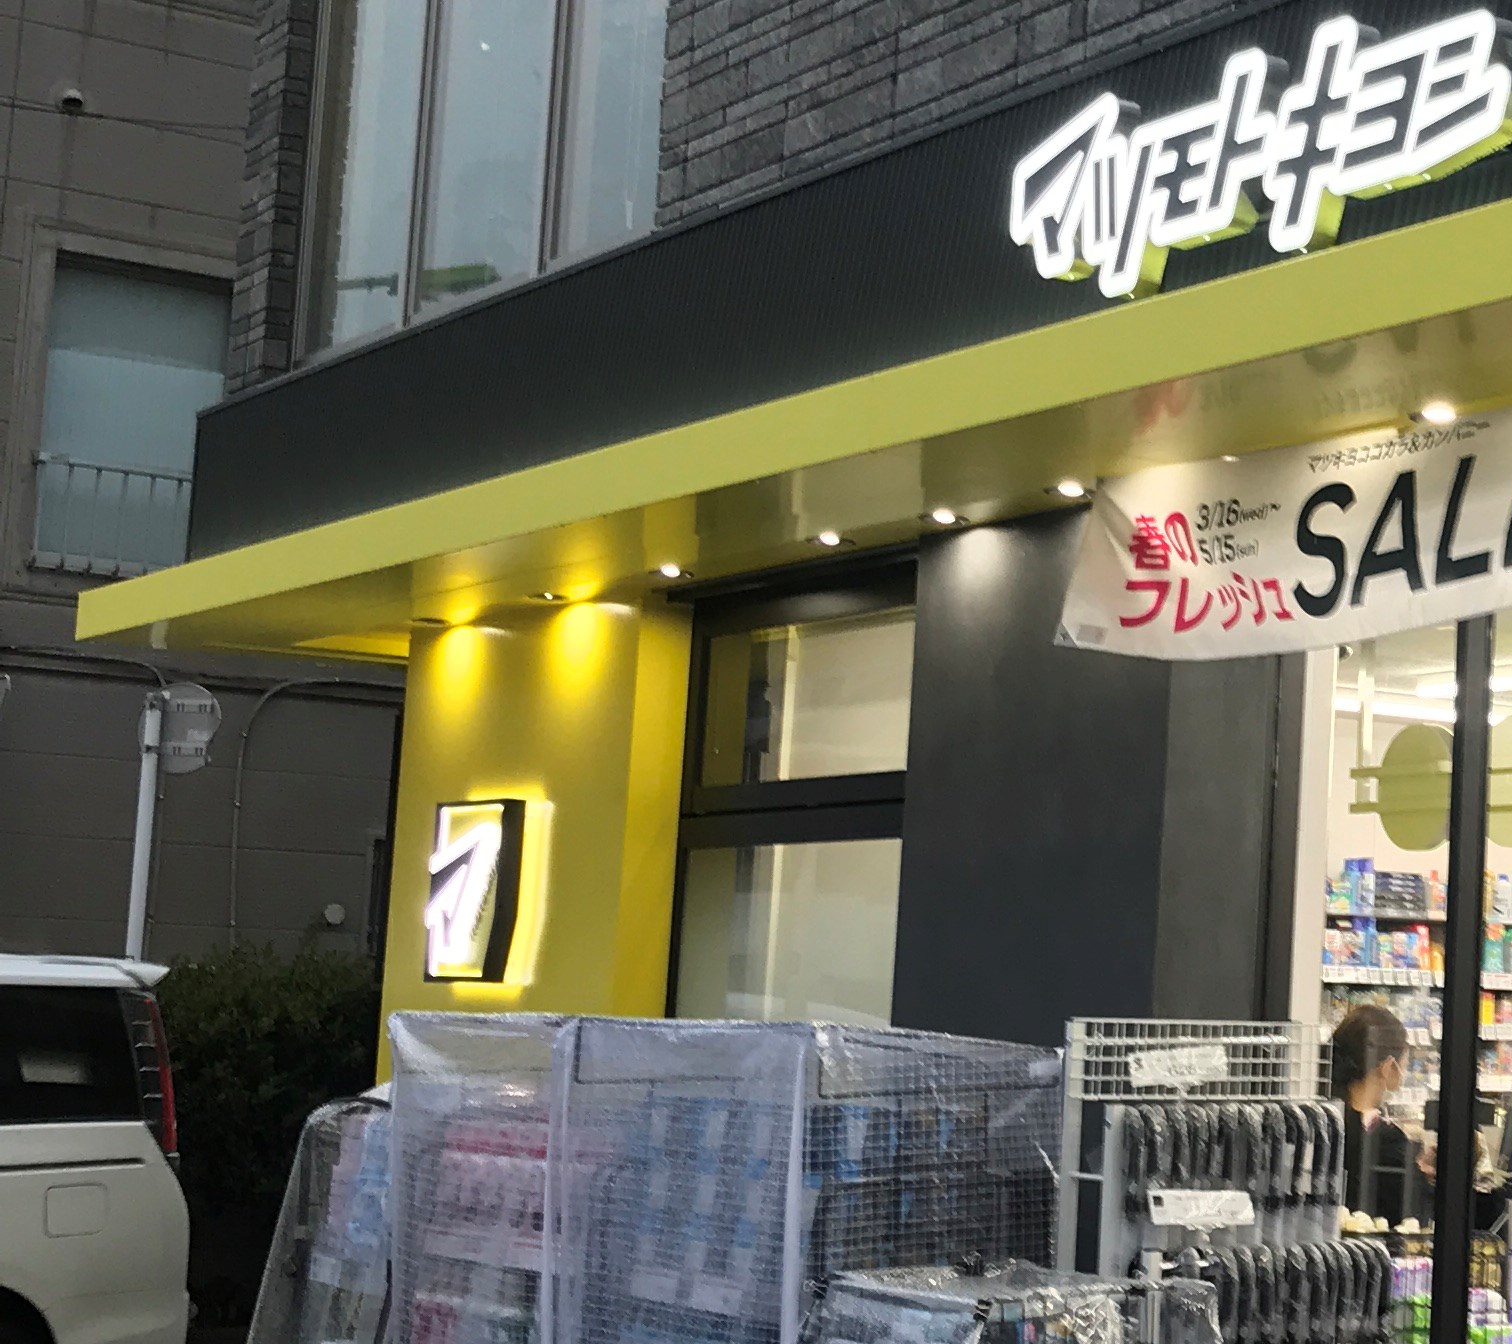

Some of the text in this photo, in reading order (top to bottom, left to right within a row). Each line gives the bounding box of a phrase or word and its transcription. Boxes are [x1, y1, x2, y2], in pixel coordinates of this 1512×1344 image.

[1128, 511, 1200, 573] 春の
[1118, 571, 1296, 634] フレッシュ
